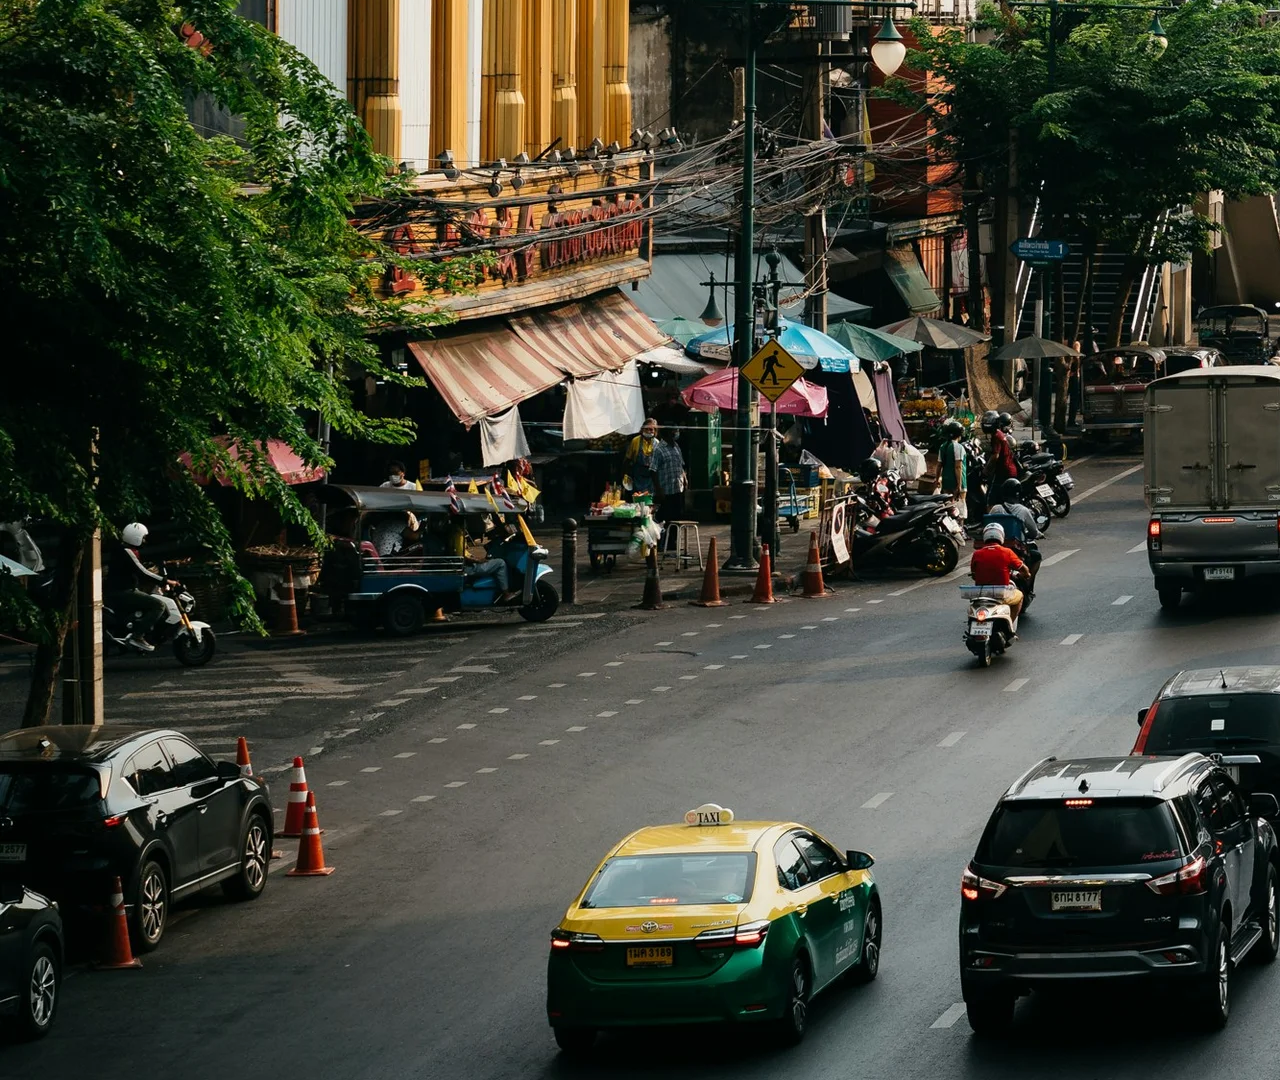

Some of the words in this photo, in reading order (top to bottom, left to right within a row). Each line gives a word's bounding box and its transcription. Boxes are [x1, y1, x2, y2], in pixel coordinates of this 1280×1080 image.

[697, 812, 720, 824] TAXI
[1076, 892, 1098, 902] 8177
[649, 948, 672, 958] 3189
